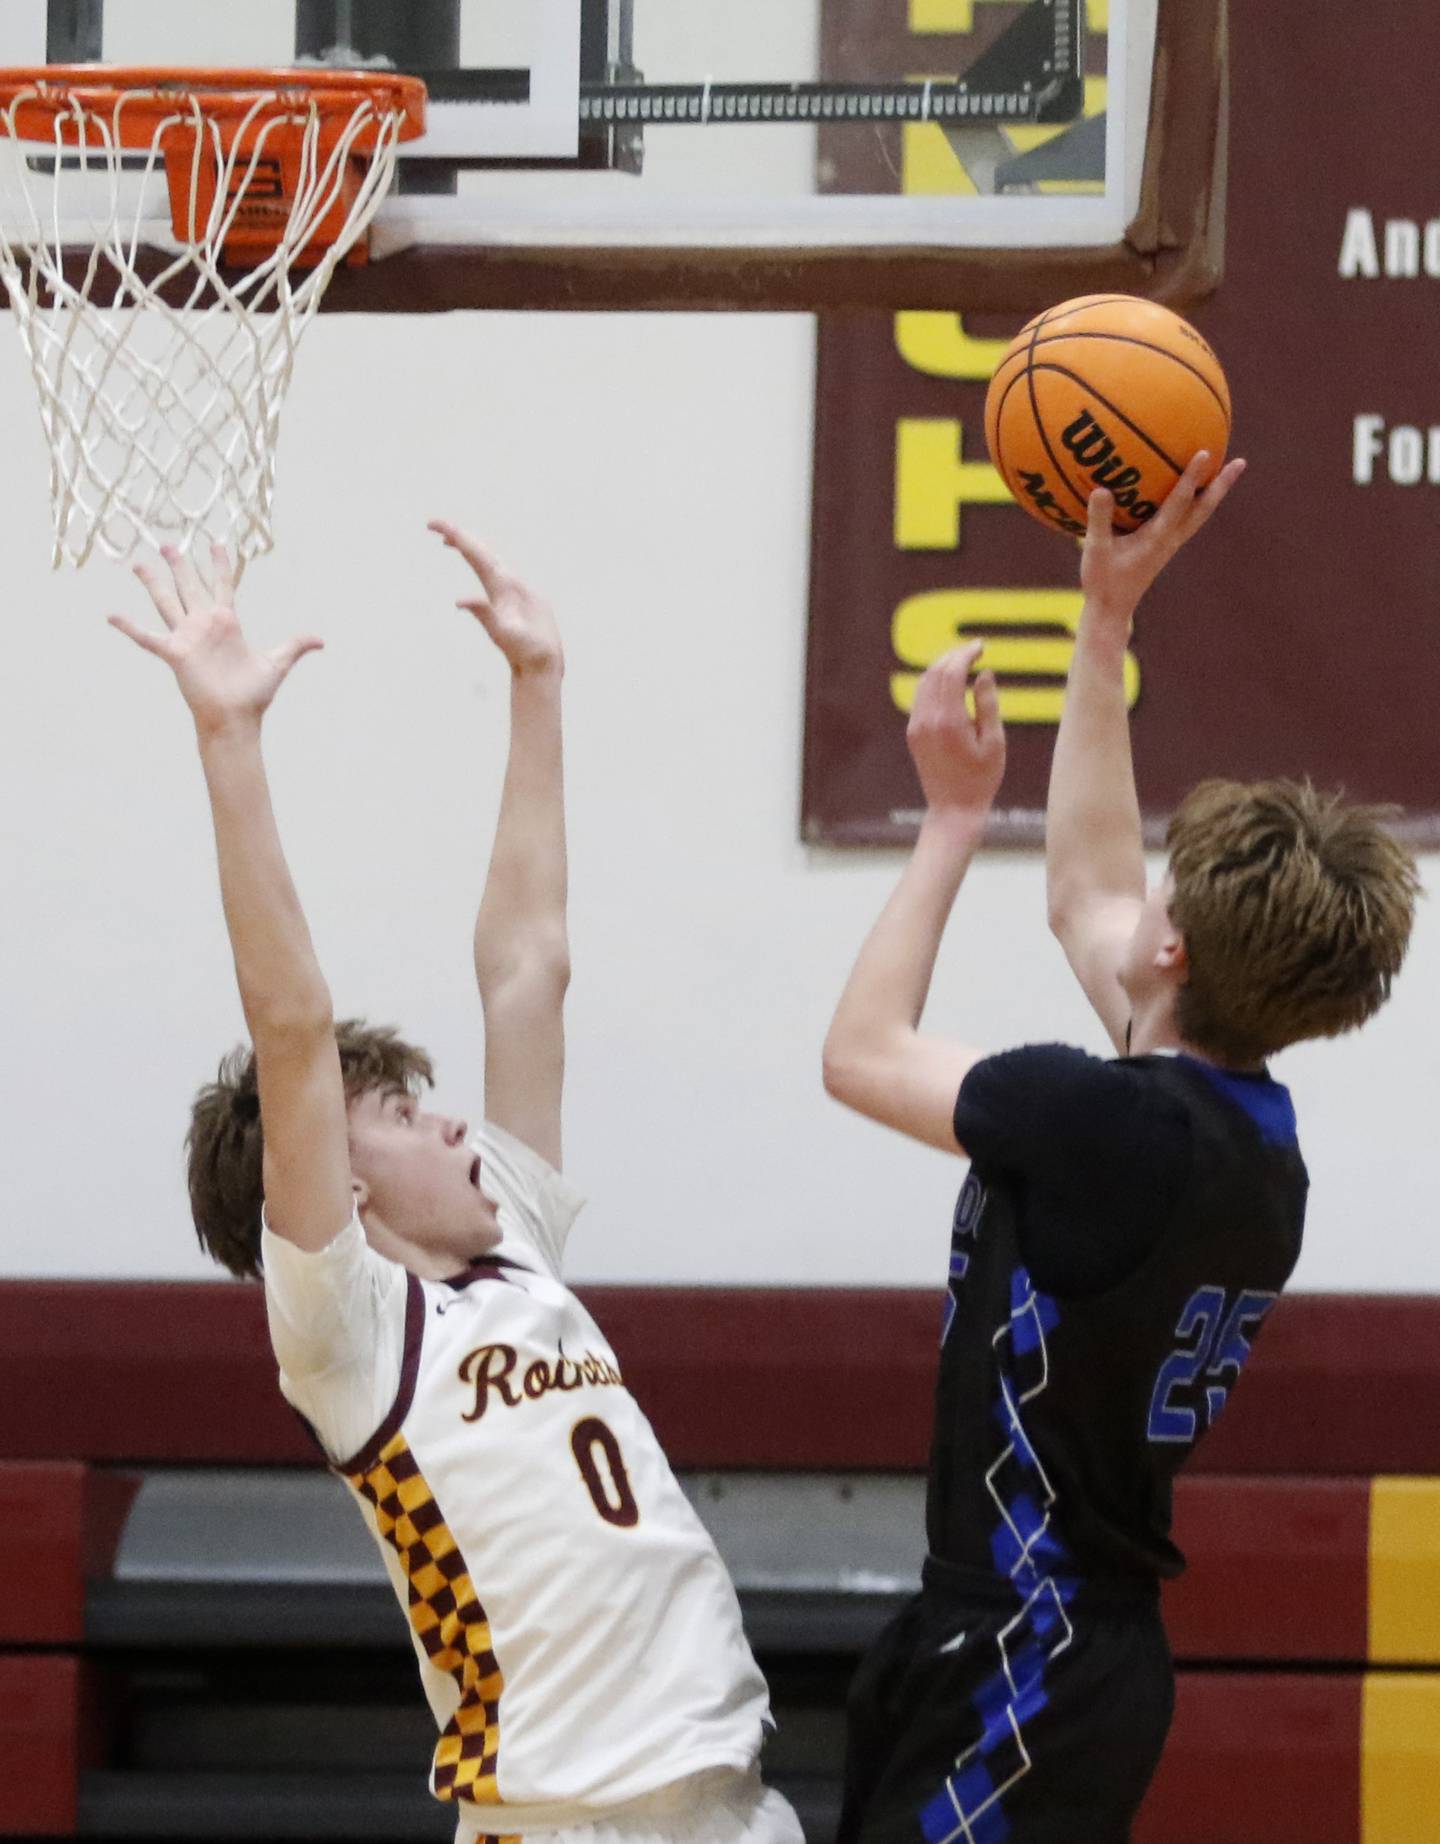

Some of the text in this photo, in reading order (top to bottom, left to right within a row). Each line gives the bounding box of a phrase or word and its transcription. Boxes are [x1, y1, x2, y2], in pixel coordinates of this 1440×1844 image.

[1061, 408, 1160, 521] Wilso
[1147, 1283, 1280, 1443] 25
[569, 1415, 639, 1528] 0
